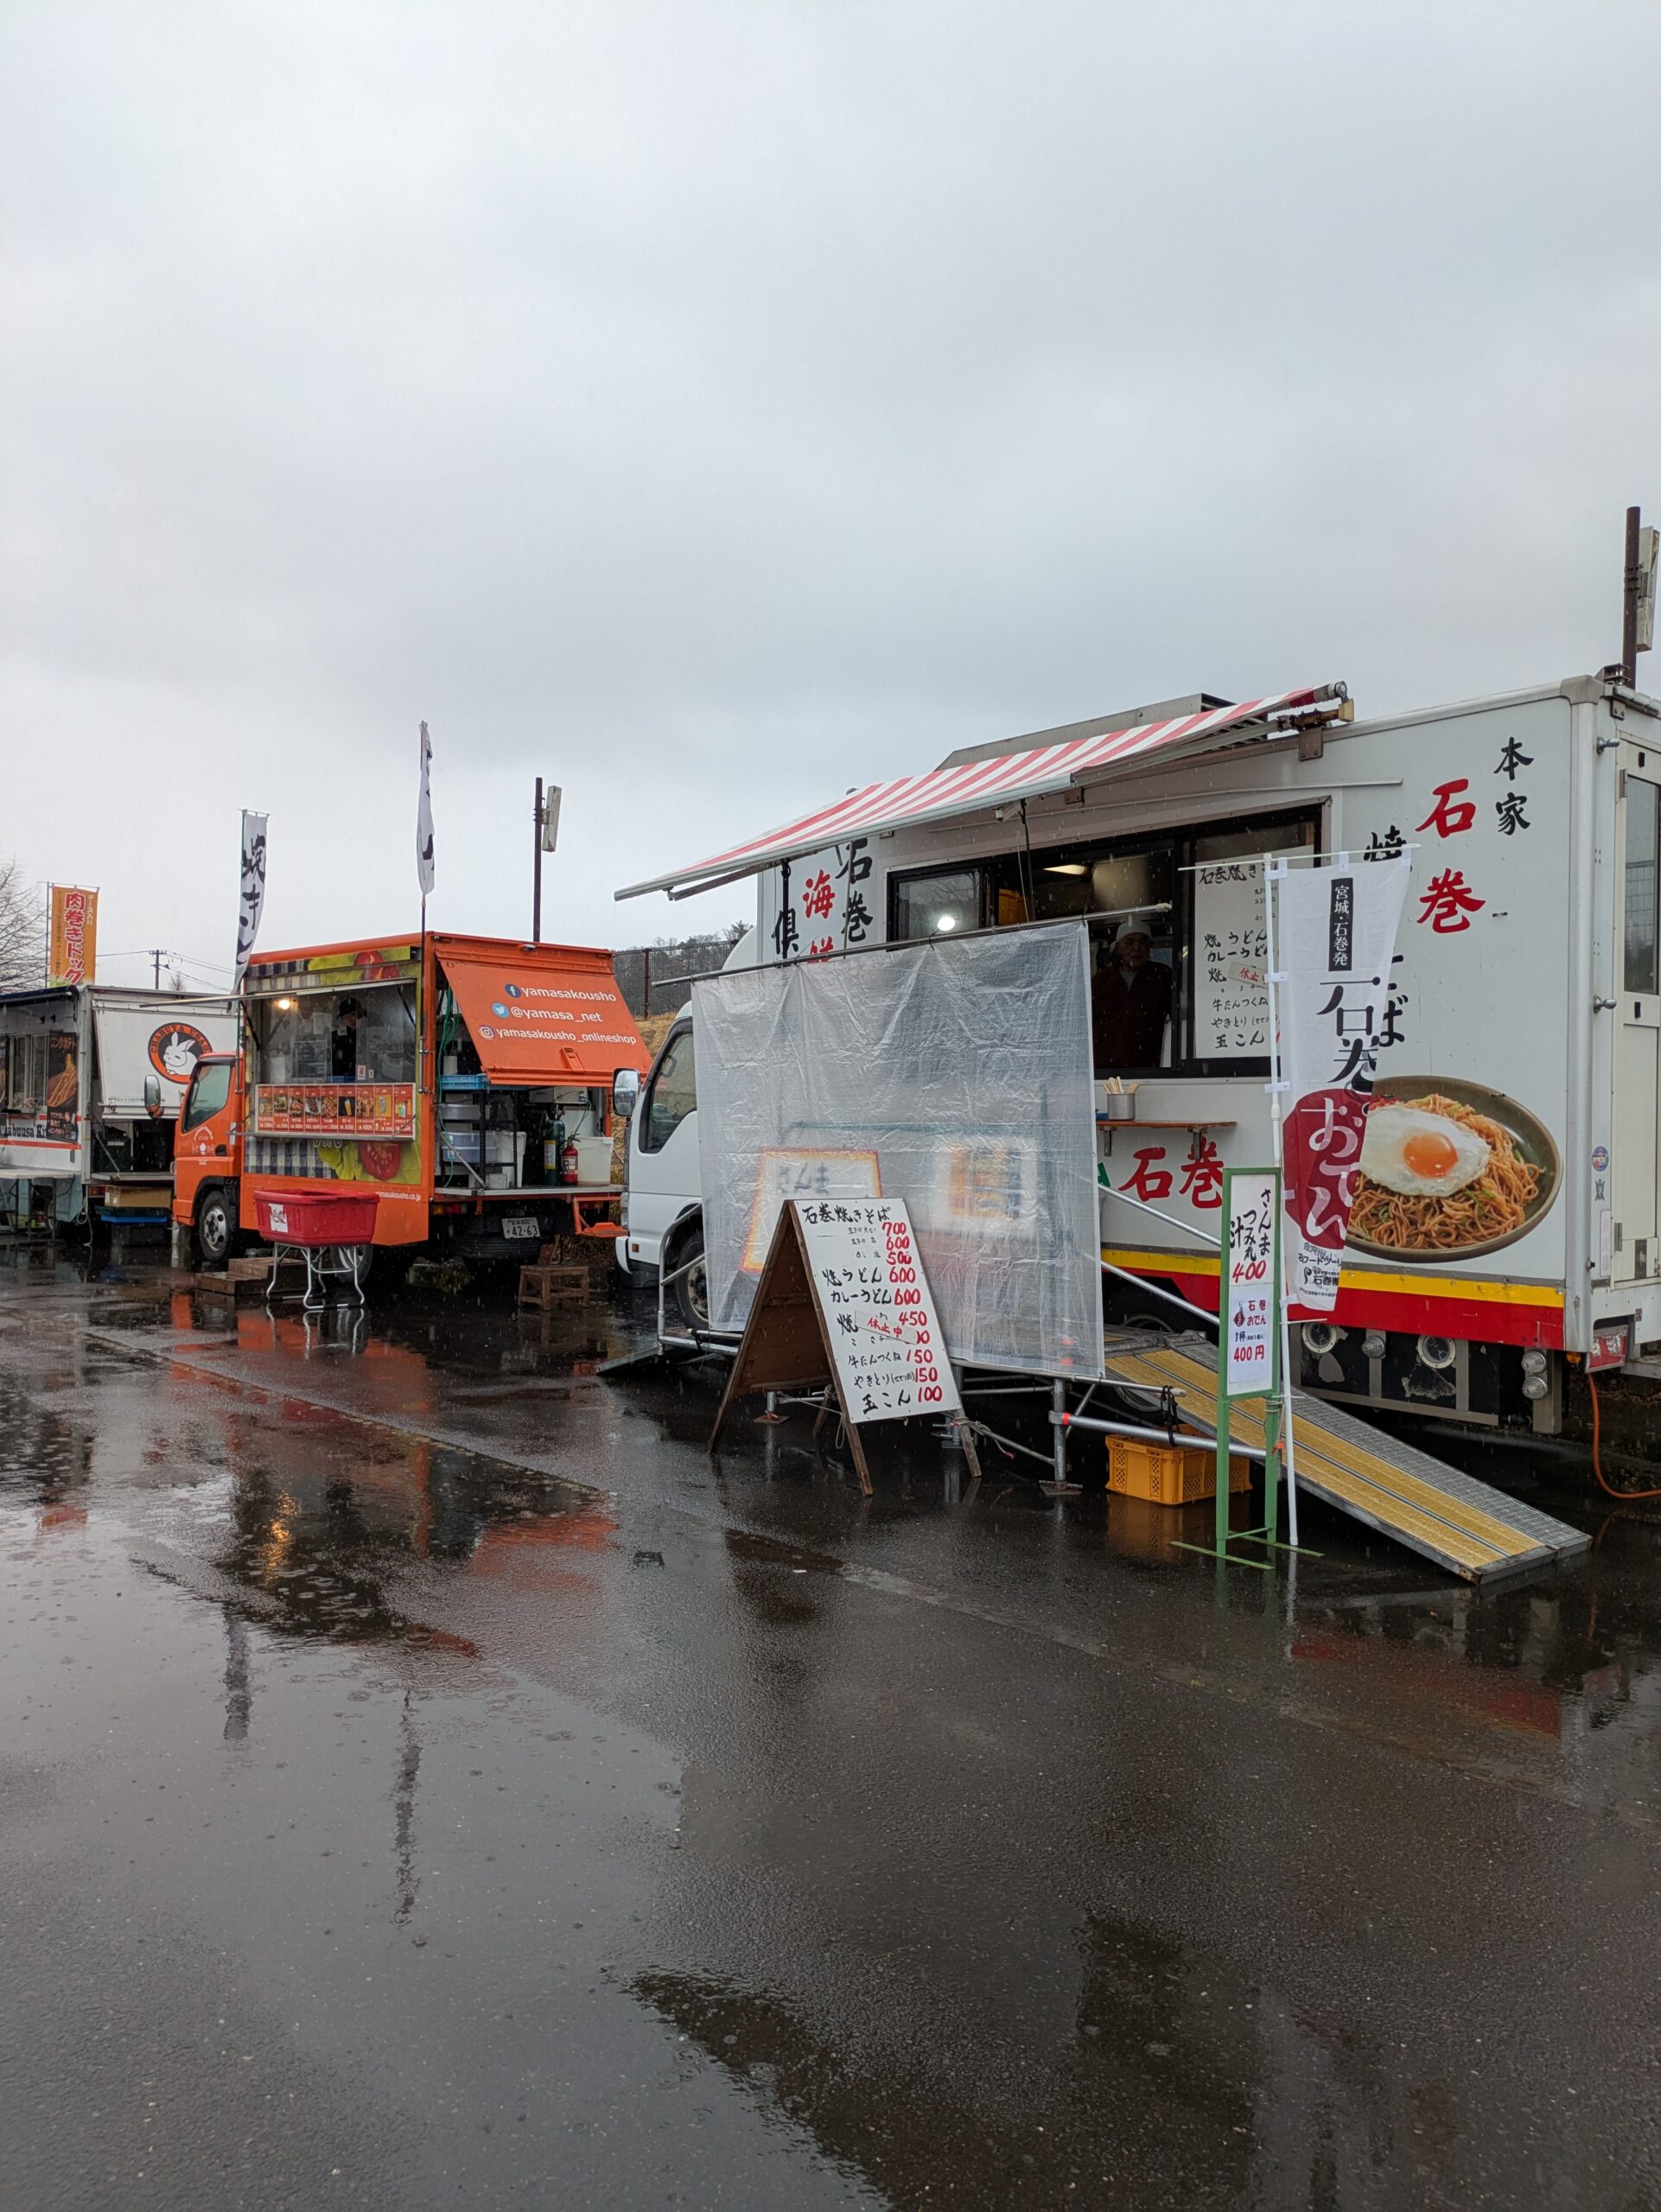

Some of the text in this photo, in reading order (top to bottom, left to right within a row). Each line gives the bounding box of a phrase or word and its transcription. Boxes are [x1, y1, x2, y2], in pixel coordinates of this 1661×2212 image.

[1493, 736, 1534, 836] 本家
[1415, 779, 1486, 933] 石巻
[835, 838, 874, 943] 石巻
[1333, 884, 1349, 967] 宮城・石巻発
[64, 892, 86, 985] 肉巻きドッグ
[521, 987, 616, 1002] yamasakousho
[496, 1027, 636, 1046] yamasakousho_onlineshop
[1118, 1136, 1224, 1208] 石巻
[1301, 1096, 1364, 1240] おでん
[802, 1202, 891, 1224] 石巻焼きそば
[1258, 1188, 1271, 1255] さんま
[881, 1221, 907, 1236] 700
[1243, 1210, 1257, 1262] つみれ
[886, 1236, 910, 1251] 600
[886, 1251, 913, 1266] 500
[821, 1267, 916, 1287] 焼うどん 600
[1231, 1260, 1267, 1284] 400
[830, 1287, 921, 1306] カレーうどん 600
[1248, 1299, 1267, 1312] 石巻
[837, 1310, 927, 1336] 焼 450
[867, 1317, 903, 1338] 休止中
[1246, 1314, 1267, 1327] おでん
[906, 1349, 933, 1363] 150
[915, 1367, 939, 1382] 150
[917, 1385, 943, 1402] 100
